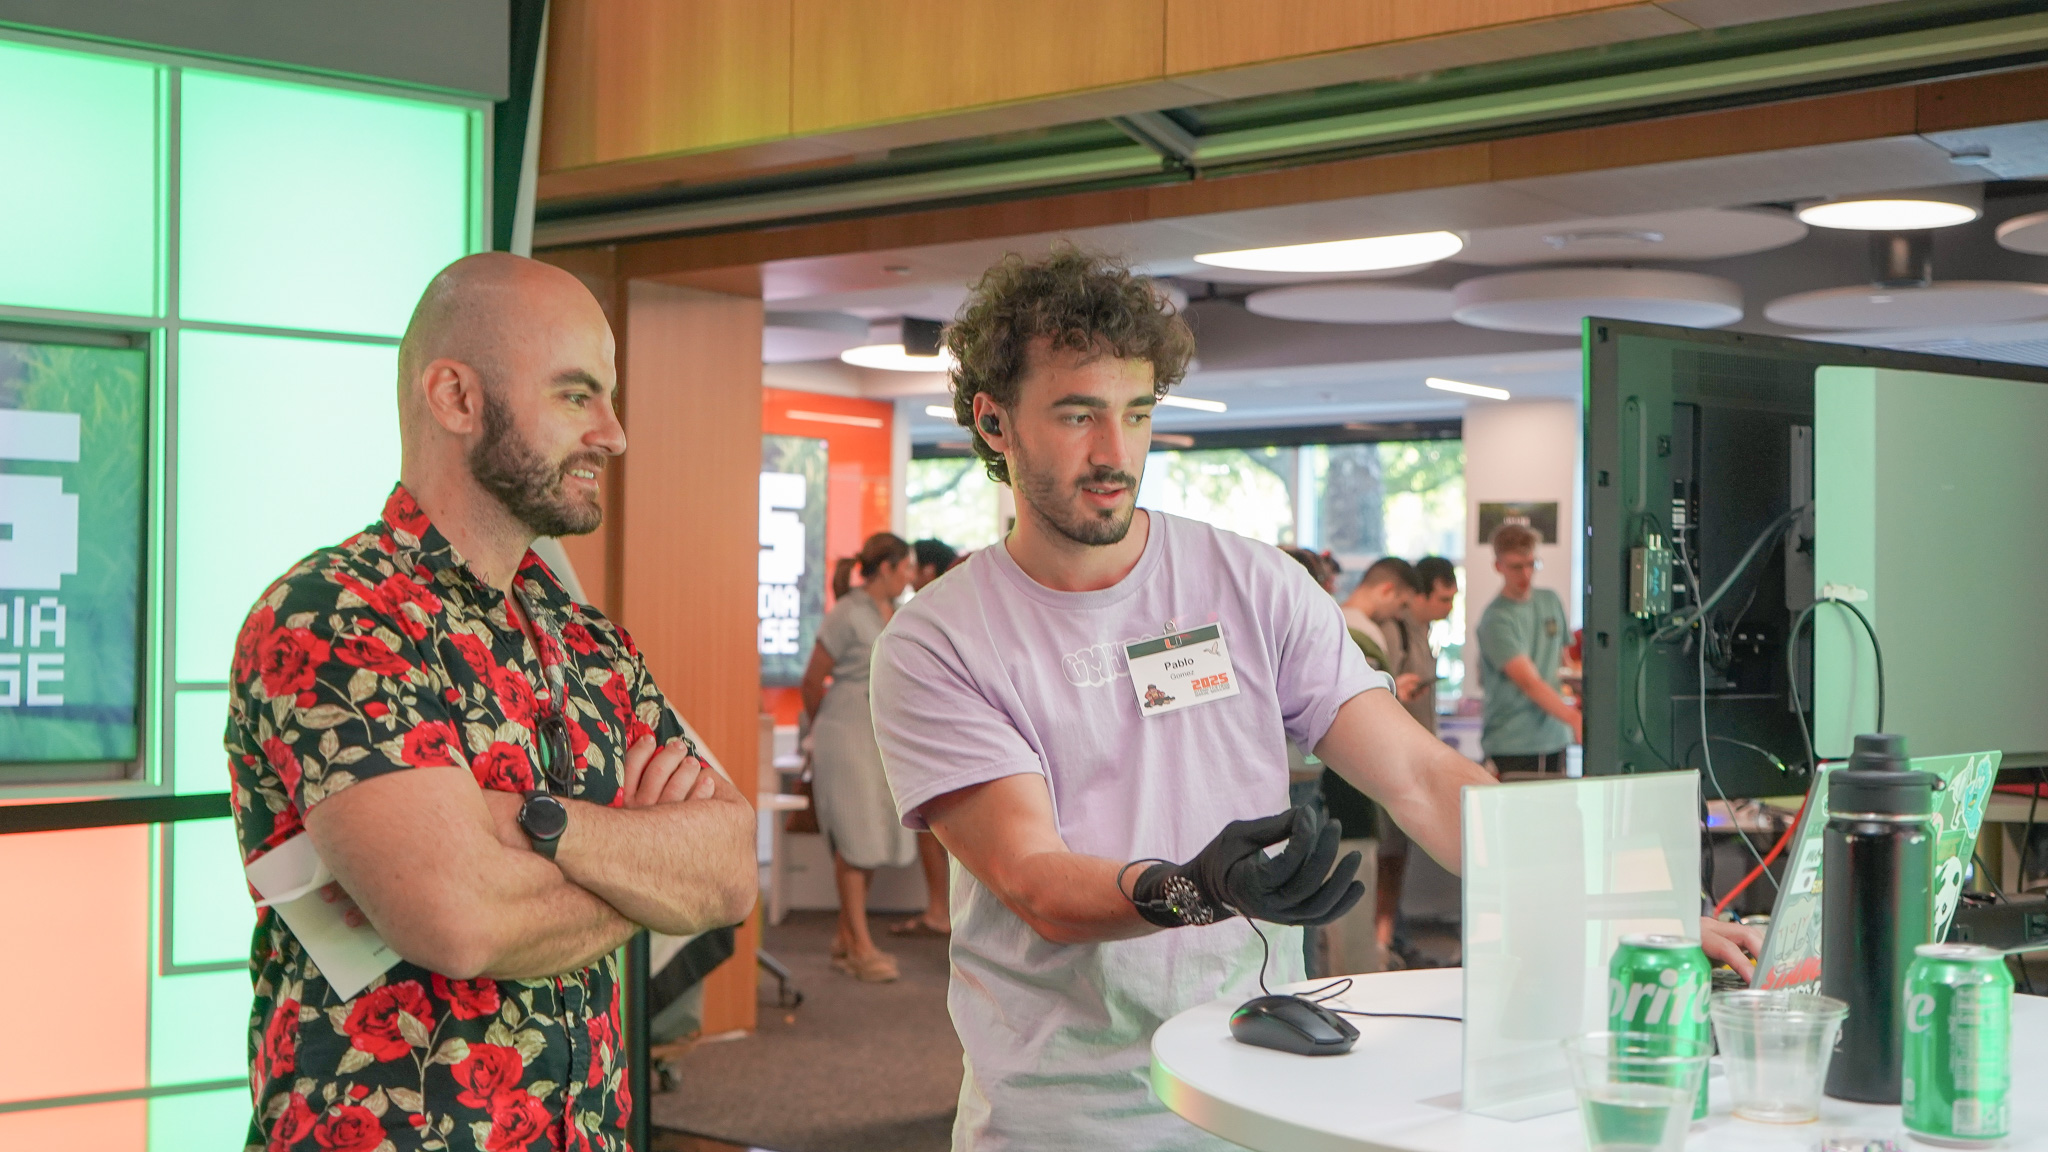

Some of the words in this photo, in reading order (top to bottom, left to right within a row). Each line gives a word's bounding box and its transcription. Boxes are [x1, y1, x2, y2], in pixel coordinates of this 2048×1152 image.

[0, 596, 66, 648] IA
[1164, 657, 1195, 671] Pablo
[1170, 669, 1195, 681] Gomez
[1191, 672, 1229, 691] 2025
